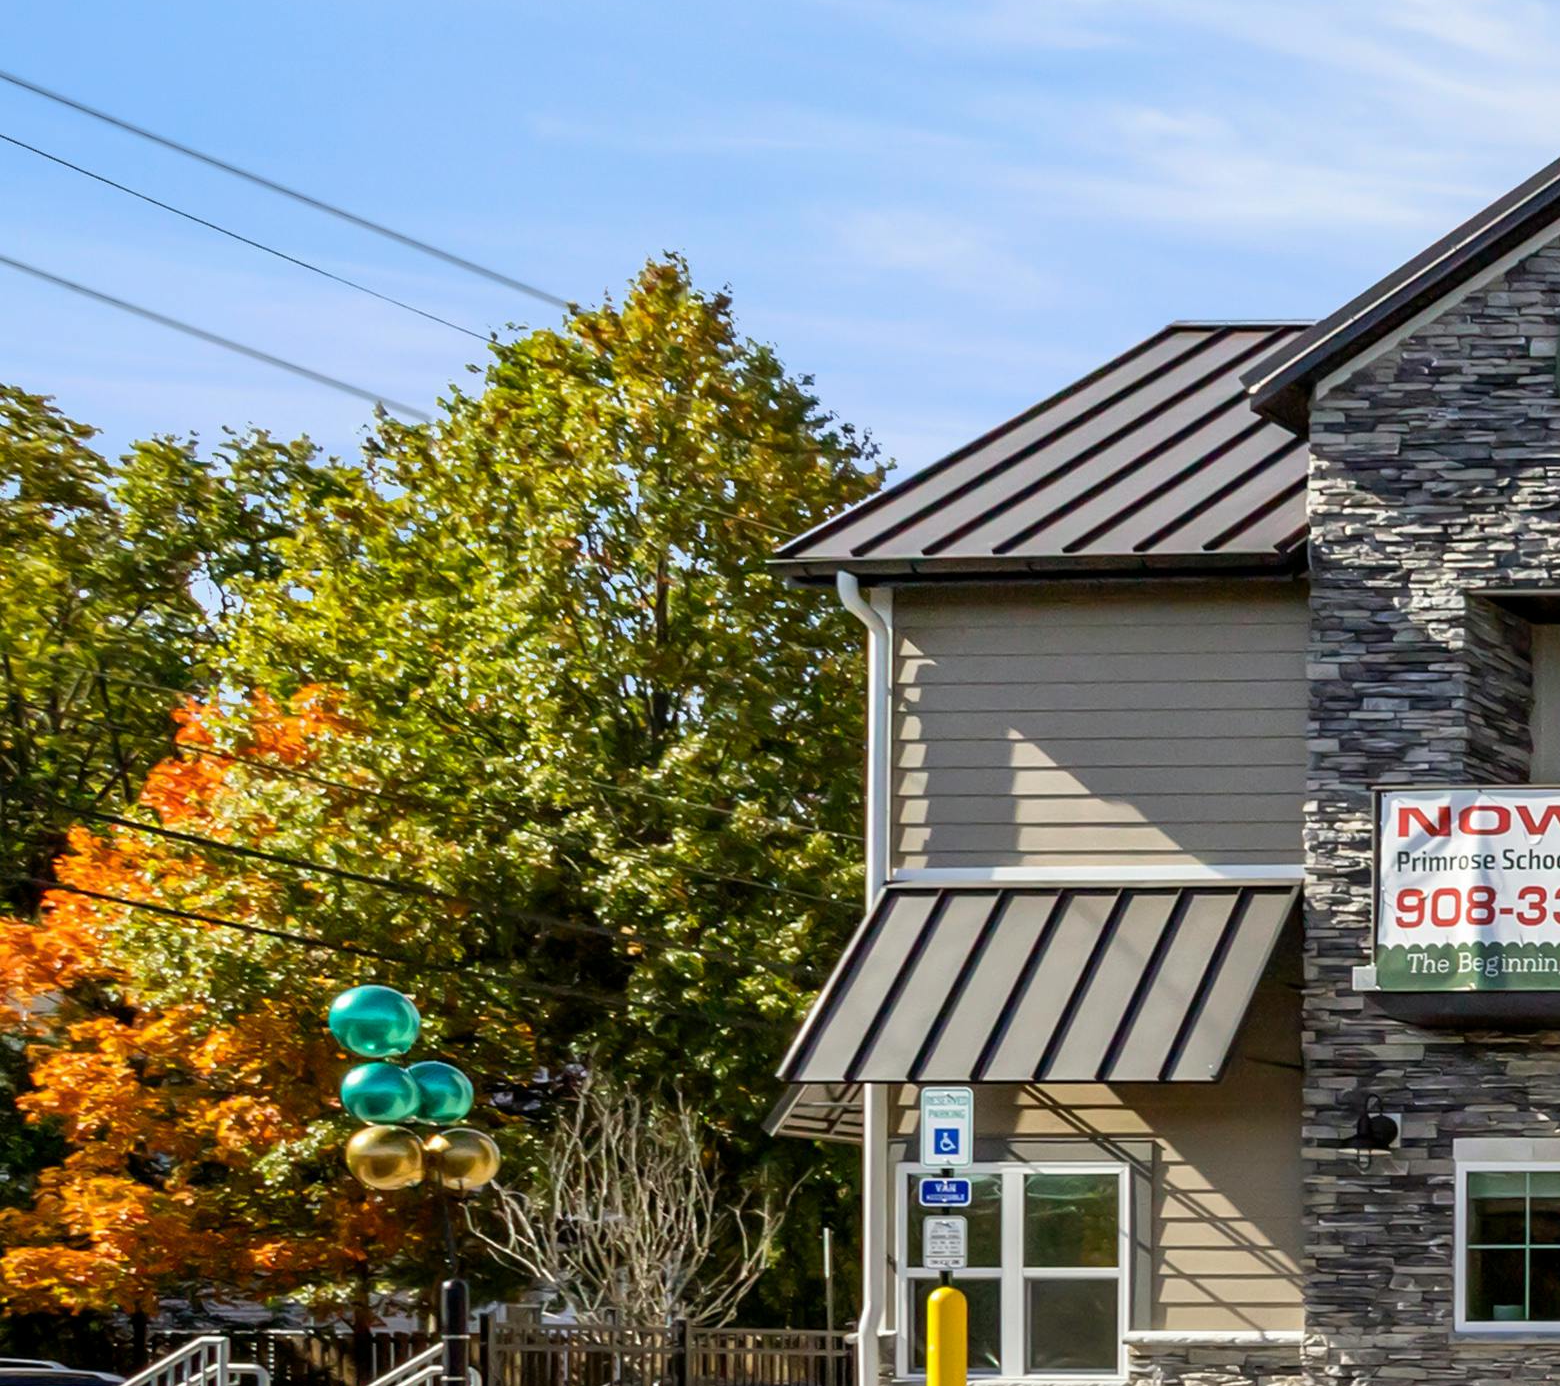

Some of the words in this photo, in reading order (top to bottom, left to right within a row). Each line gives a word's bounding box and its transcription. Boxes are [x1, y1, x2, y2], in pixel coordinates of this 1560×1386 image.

[1396, 847, 1496, 873] Primrose
[1407, 953, 1450, 974] The
[935, 1183, 957, 1193] VAN
